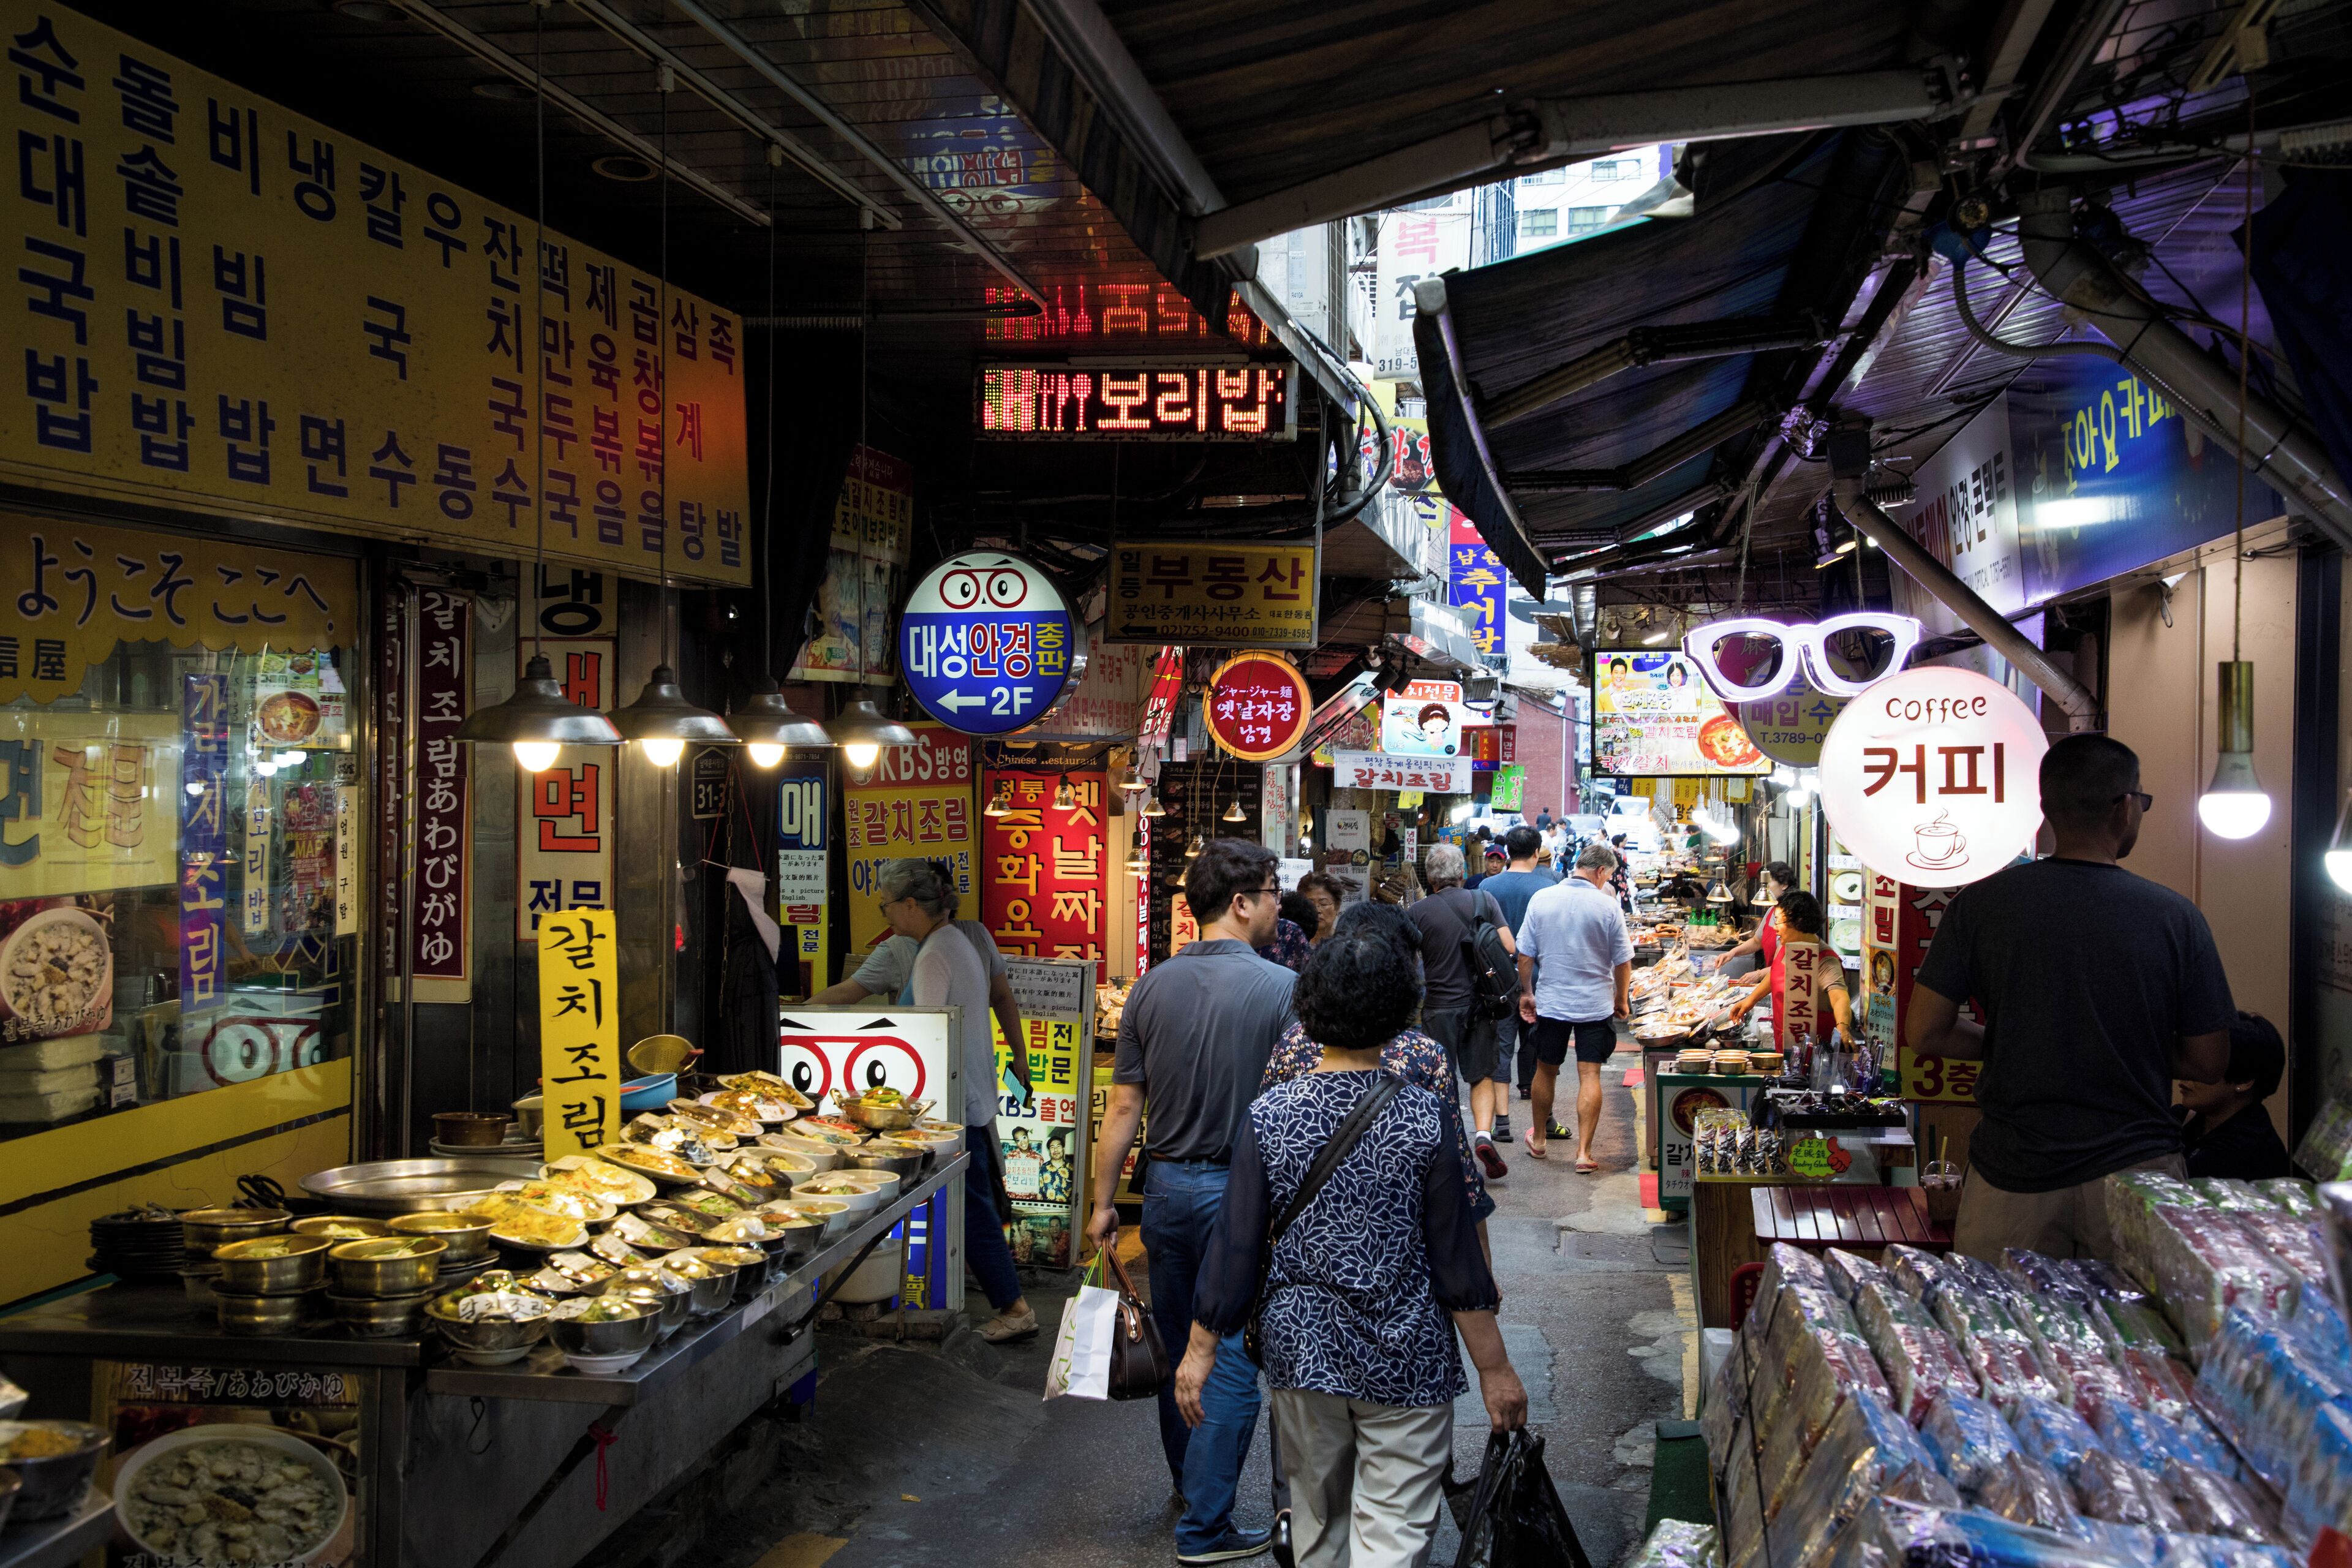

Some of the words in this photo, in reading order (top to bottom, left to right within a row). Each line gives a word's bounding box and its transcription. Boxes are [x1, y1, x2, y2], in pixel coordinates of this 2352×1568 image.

[8, 15, 98, 454] 순대국밥
[112, 53, 195, 473] 돌솥비빔밥
[208, 97, 276, 486] 비빔밥
[287, 130, 349, 499] 냉면
[359, 161, 417, 509] 칼국수
[424, 192, 477, 521] 우동
[483, 216, 532, 529] 잔치국수
[537, 238, 581, 539] 떡만두국
[585, 262, 627, 546] 제육볶음
[628, 277, 668, 554] 곱창볶음
[671, 298, 707, 562] 삼계탕
[708, 312, 743, 568] 족발
[1147, 555, 1306, 601] 부동산
[1161, 625, 1250, 638] 02)752-9400
[1253, 627, 1311, 638] 010-7339-4585
[421, 592, 462, 778] 갈치조림
[910, 622, 1031, 679] 대성안경
[992, 687, 1034, 715] 2F
[879, 734, 933, 781] KBS
[935, 745, 968, 779] 방영
[997, 755, 1037, 764] Chinese
[1239, 724, 1272, 744] 남경
[1354, 767, 1452, 791] 갈치조림
[1365, 756, 1383, 767] 평창
[1386, 759, 1404, 768] 동계
[1405, 758, 1433, 771] 올림픽
[1644, 726, 1698, 740] 갈치조림
[1863, 742, 2005, 804] 커피
[184, 677, 227, 1005] 갈치조림
[421, 778, 459, 966] あわびがゆ
[848, 798, 862, 848] 원조
[862, 796, 968, 845] 갈치조림
[957, 850, 970, 895] 전문
[802, 929, 820, 952] 전문
[544, 919, 607, 1149] 갈치조림
[1040, 1096, 1076, 1123] 출연
